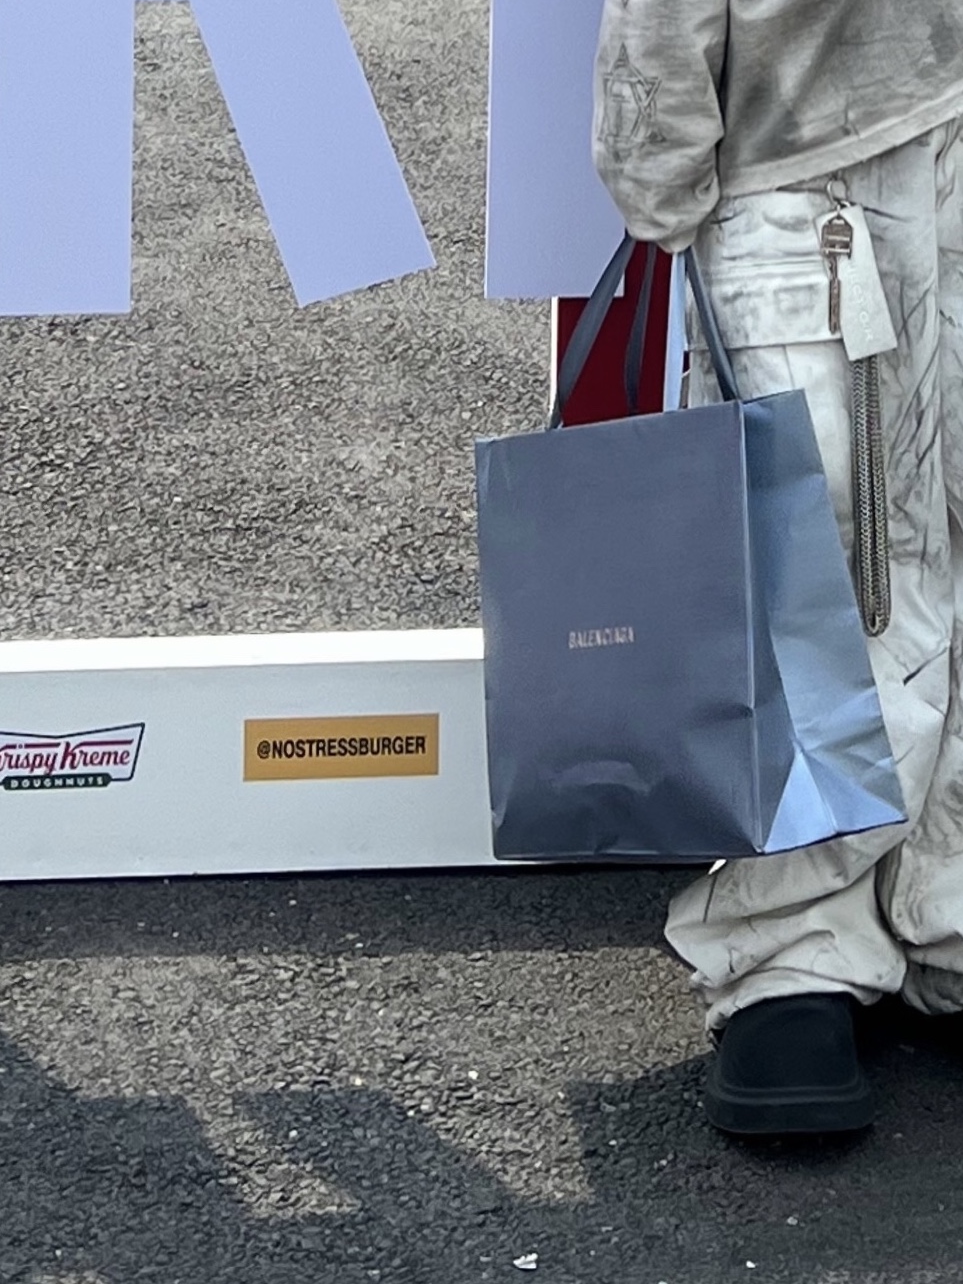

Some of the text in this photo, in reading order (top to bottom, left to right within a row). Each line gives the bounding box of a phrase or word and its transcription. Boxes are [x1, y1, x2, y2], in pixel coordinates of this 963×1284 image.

[0, 739, 134, 776] rispy Kreme
[257, 735, 427, 760] @NOSTRESSBURGER
[10, 776, 104, 789] DOUGHNUTS
